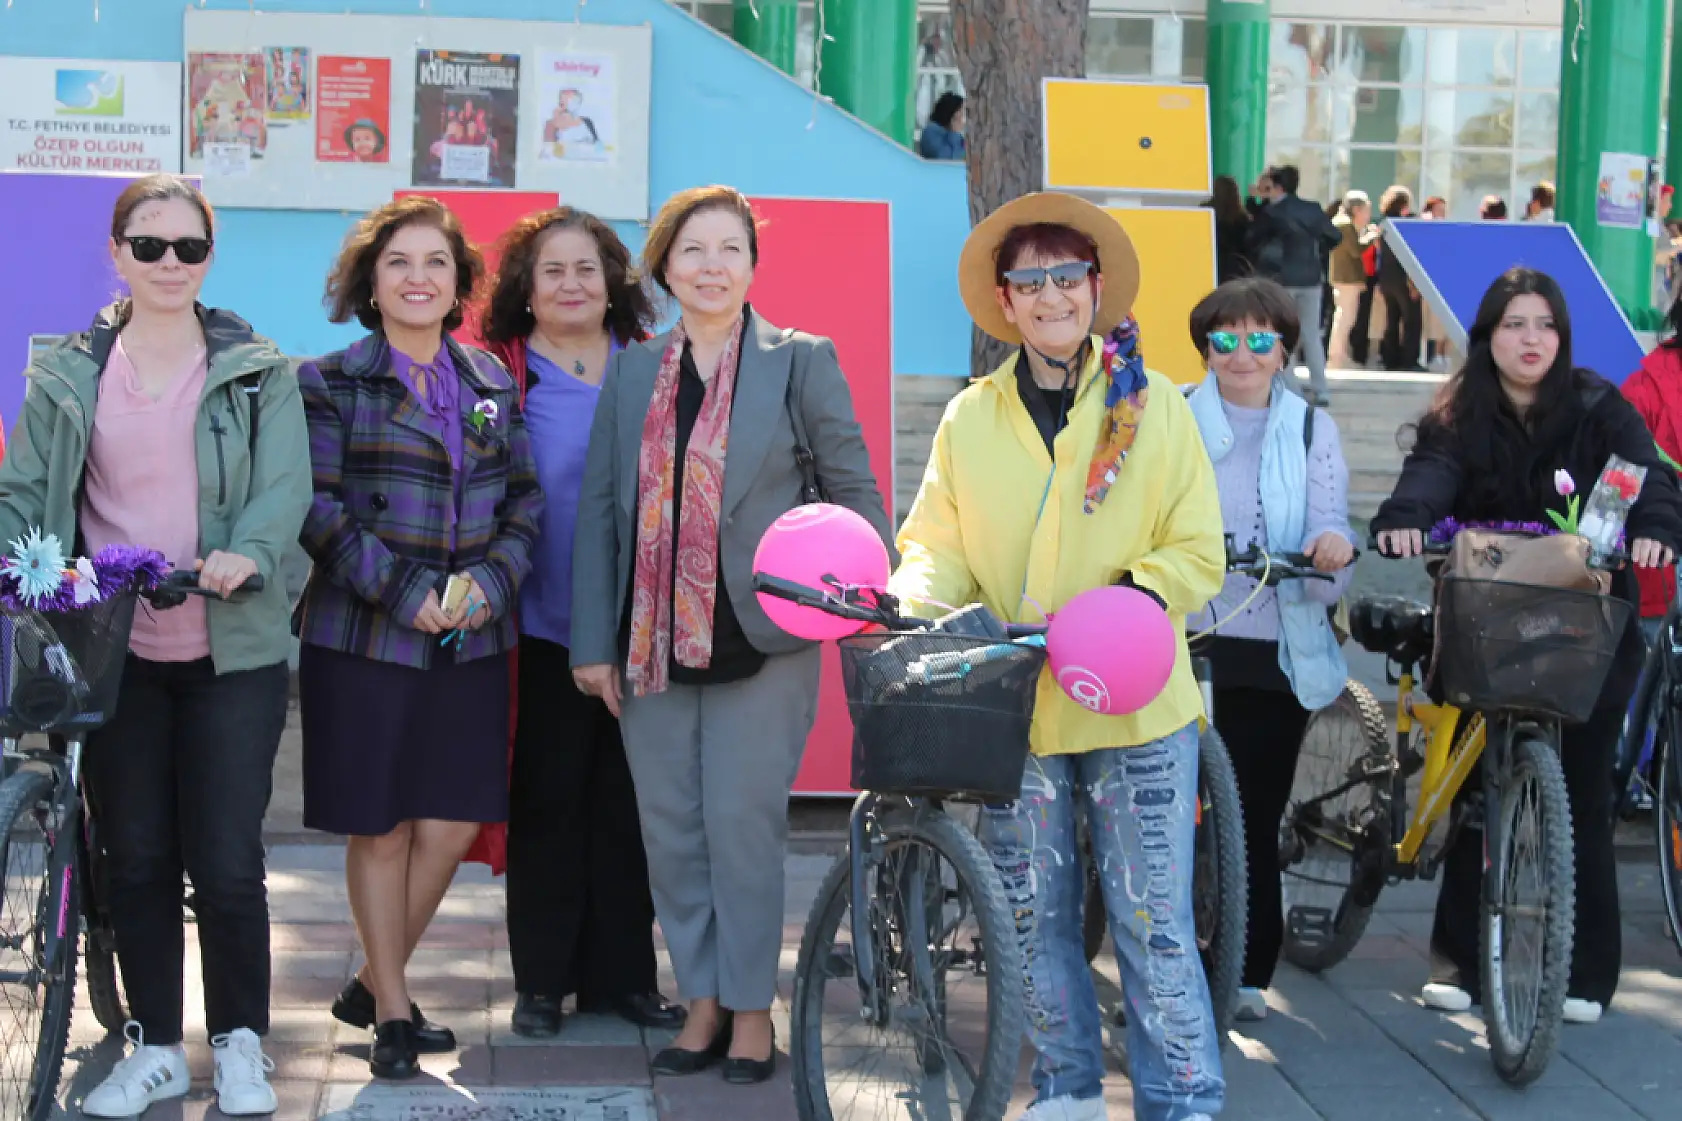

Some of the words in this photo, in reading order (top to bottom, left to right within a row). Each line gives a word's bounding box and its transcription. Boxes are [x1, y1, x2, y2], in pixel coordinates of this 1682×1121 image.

[34, 135, 79, 151] ÖZER
[83, 139, 144, 154] OLGUN
[17, 152, 82, 168] KÜLTÜR
